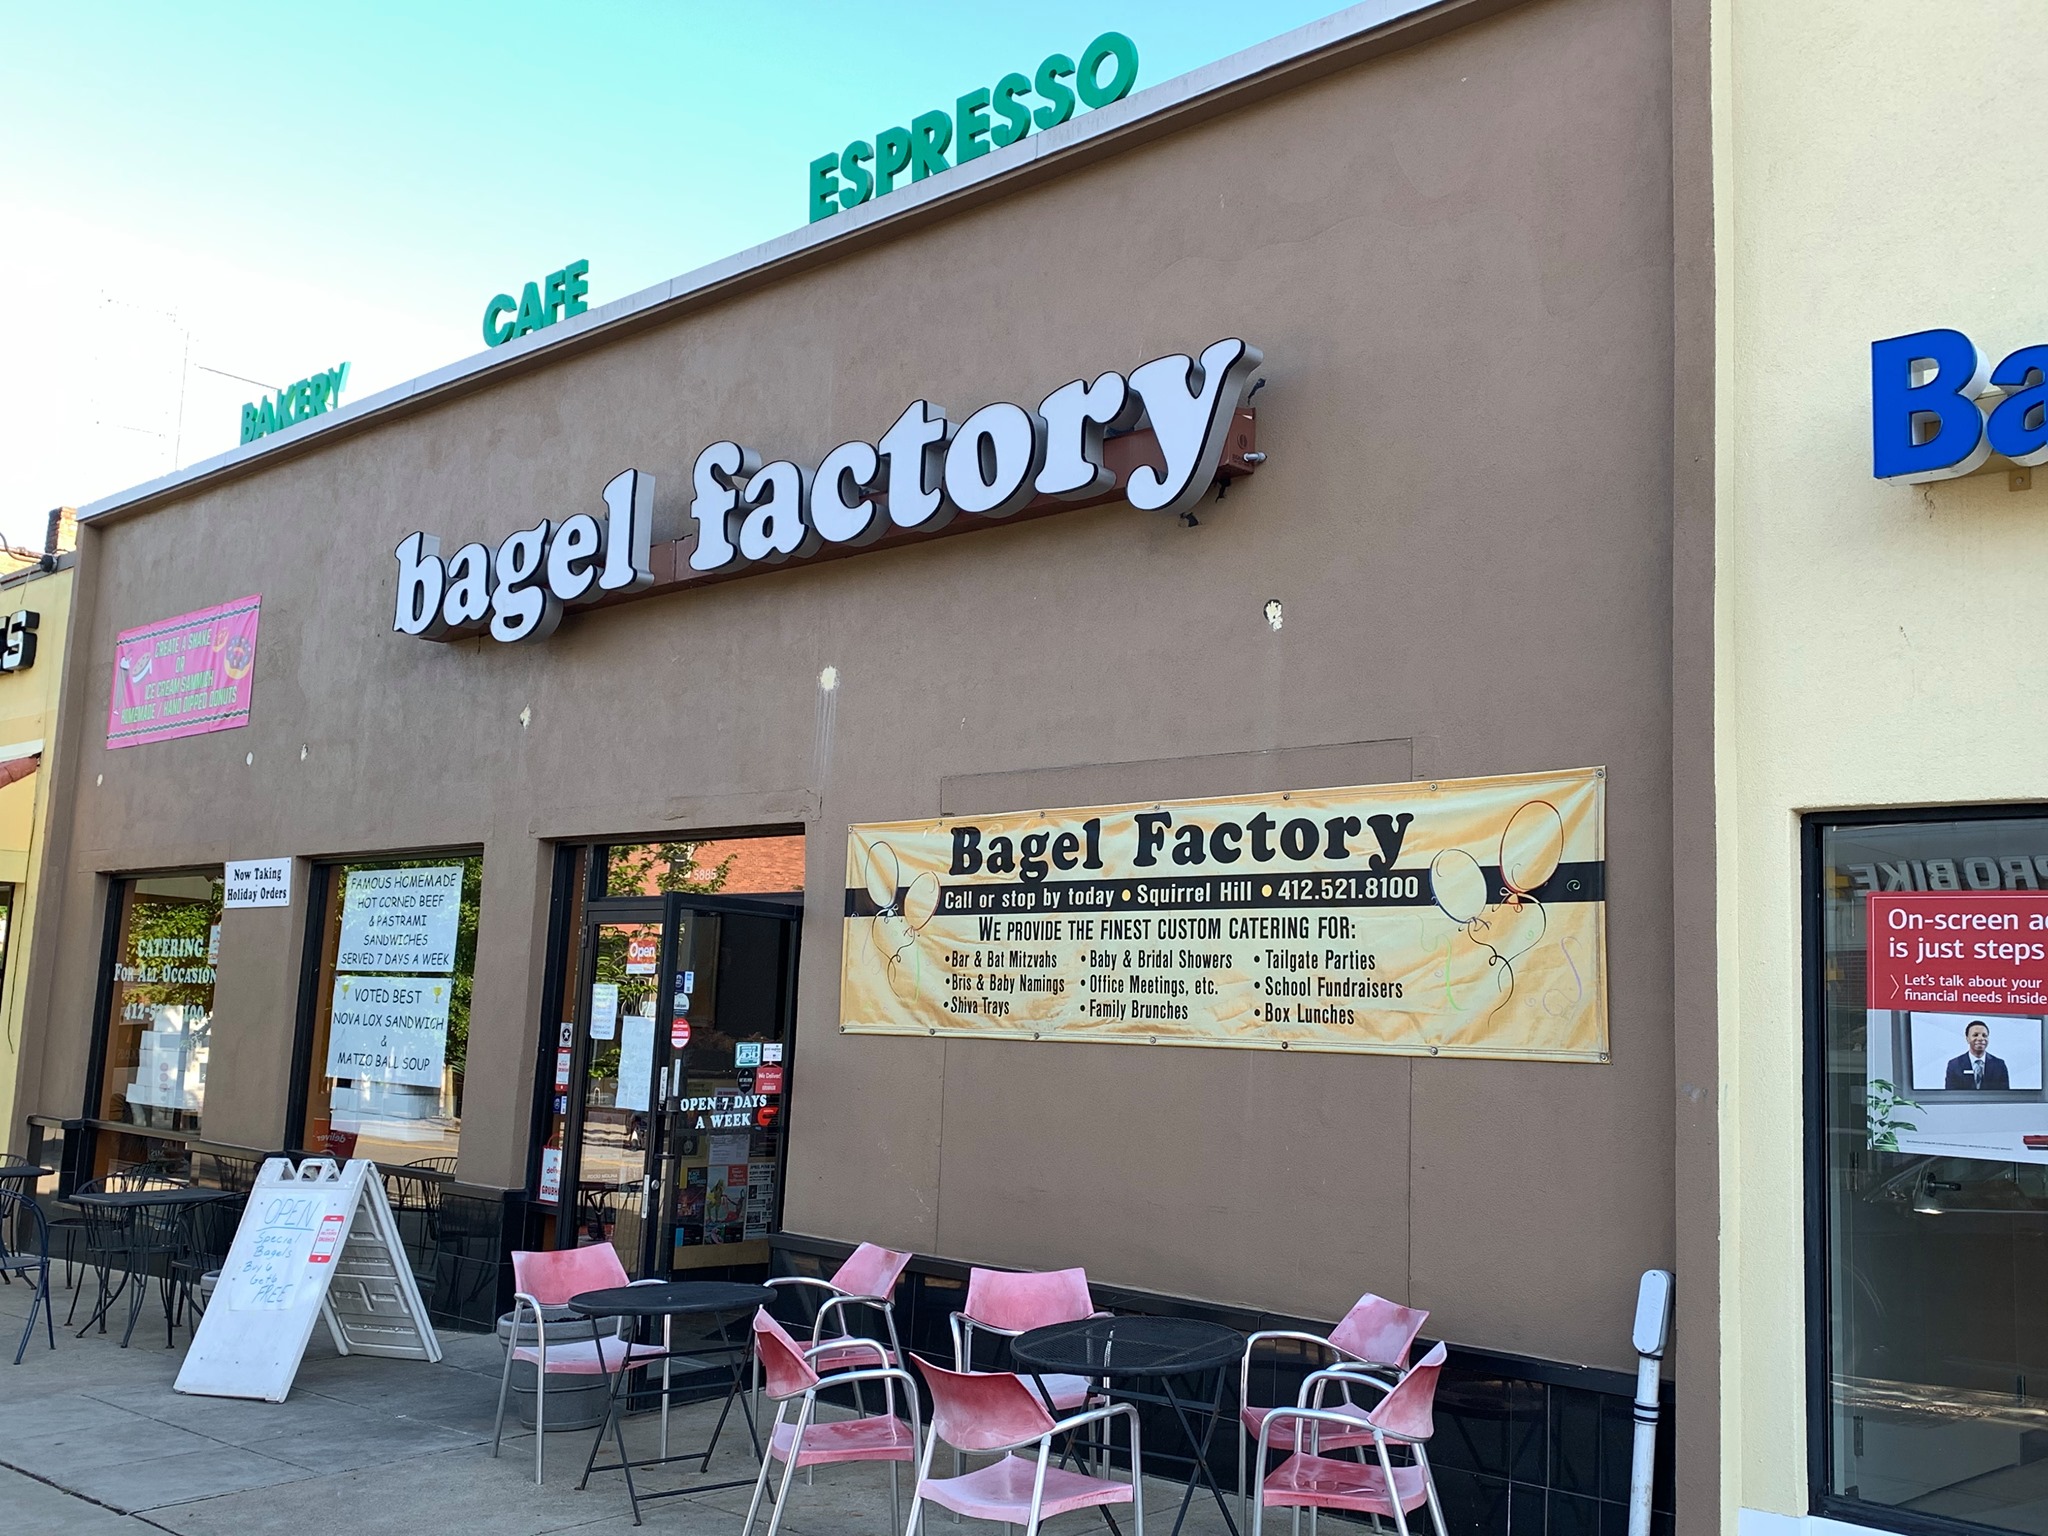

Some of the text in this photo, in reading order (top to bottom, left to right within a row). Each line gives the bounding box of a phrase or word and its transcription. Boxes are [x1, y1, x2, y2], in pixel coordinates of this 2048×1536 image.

[809, 32, 1138, 223] ESPRESSO
[483, 259, 588, 348] CAFE
[240, 361, 351, 445] BAKERY
[394, 337, 1260, 643] bagel factory
[155, 636, 180, 658] CREATE
[188, 628, 212, 650] SHAKE
[209, 685, 237, 707] DONUTS
[949, 812, 1414, 883] Bagel Factory
[233, 866, 282, 883] Now Taking
[351, 873, 457, 890] FAMOUS HOMEMADE
[227, 886, 287, 903] Holiday Orders
[357, 895, 444, 909] HOT CORNED BEEF
[945, 876, 1419, 912] Call or stop by today Squirrel Hill 412.521.8100
[368, 915, 427, 927] & PASTRAMI
[978, 916, 1356, 941] WE PROVIDE THE FINEST CUSTOM CATERING FOR:
[1888, 908, 2019, 930] On-screen
[137, 937, 204, 958] CATERING
[363, 934, 428, 946] SANDWICHES
[341, 952, 450, 966] SERVED 7 DAYS A WEEK
[630, 942, 656, 961] Open
[951, 950, 1057, 968] Bar & Bat Mitzvahs
[1090, 949, 1233, 971] Baby & Bridal Showers
[1889, 936, 2045, 965] is just steps
[1265, 950, 1376, 972] Tailgate Parties
[951, 974, 1065, 996] Bris & Baby Namings
[1090, 975, 1219, 997] Office Meetings, etc.
[1265, 976, 1403, 999] School Fundraisers
[1904, 974, 2042, 991] Let's talk about your
[354, 988, 422, 1004] VOTED BEST
[1904, 989, 2047, 1005] financial needs inside
[950, 996, 1010, 1017] Shiva Trays
[1090, 1000, 1189, 1020] Family Brunches
[1265, 1002, 1355, 1025] Box Lunches
[333, 1012, 444, 1031] NOVA LOX SANDWICH
[380, 1035, 387, 1047] &
[337, 1052, 430, 1071] MATZO BALL SOUP
[680, 1096, 717, 1111] OPEN
[722, 1097, 729, 1110] 7
[733, 1094, 767, 1109] DAYS
[695, 1112, 751, 1129] A WEEK
[264, 1198, 320, 1228] OPEN
[253, 1231, 302, 1244] Special
[253, 1245, 293, 1260] Bagels
[251, 1284, 294, 1304] FREE
